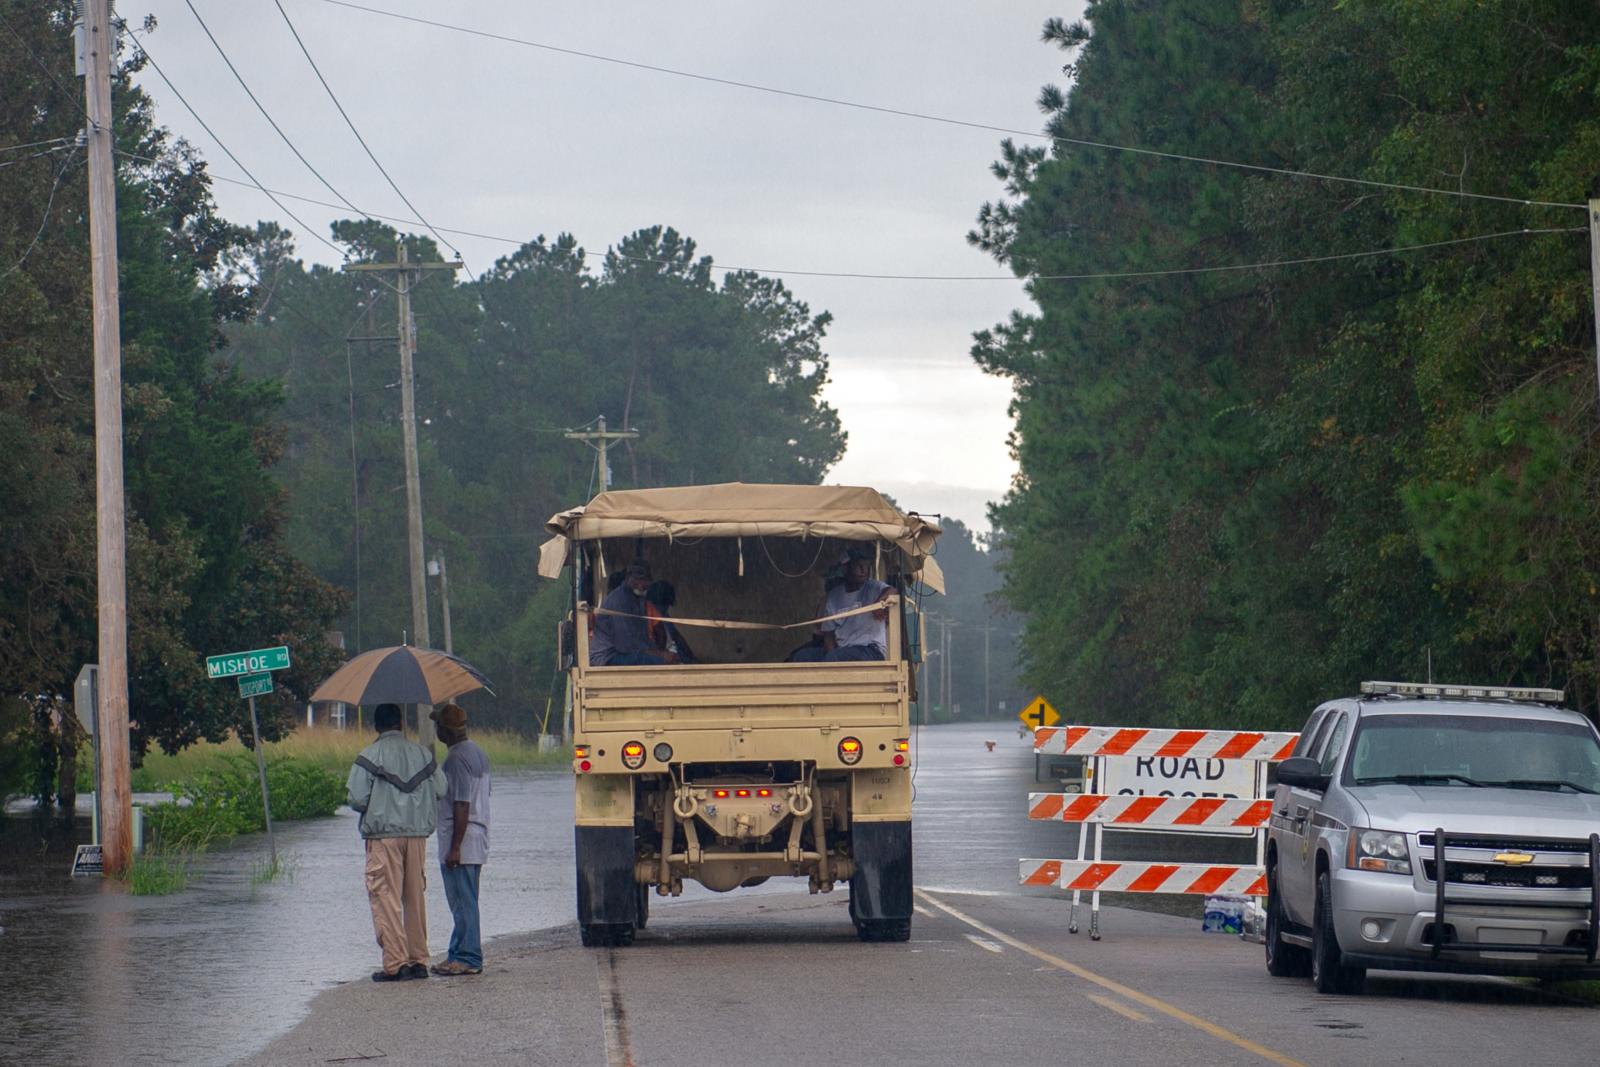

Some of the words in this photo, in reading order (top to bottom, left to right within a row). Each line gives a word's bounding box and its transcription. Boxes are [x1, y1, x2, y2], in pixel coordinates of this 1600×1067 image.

[209, 656, 268, 674] MISHOE
[276, 653, 287, 662] RD
[1136, 756, 1225, 780] ROAD
